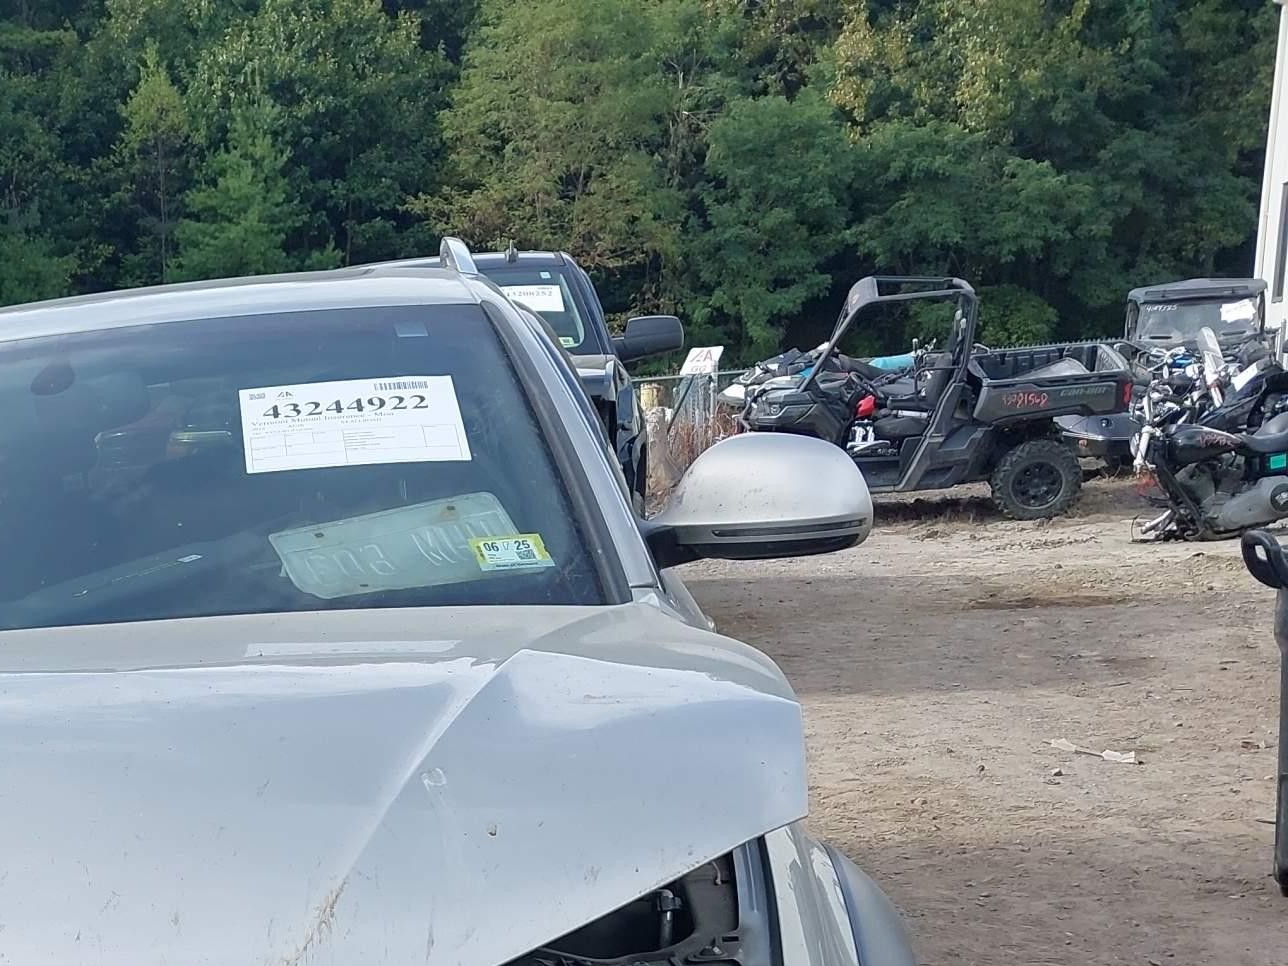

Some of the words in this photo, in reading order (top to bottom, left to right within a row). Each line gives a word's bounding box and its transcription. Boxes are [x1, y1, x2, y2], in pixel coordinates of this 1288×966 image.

[262, 394, 429, 419] 43244922
[482, 541, 499, 552] 06
[513, 540, 531, 551] 25
